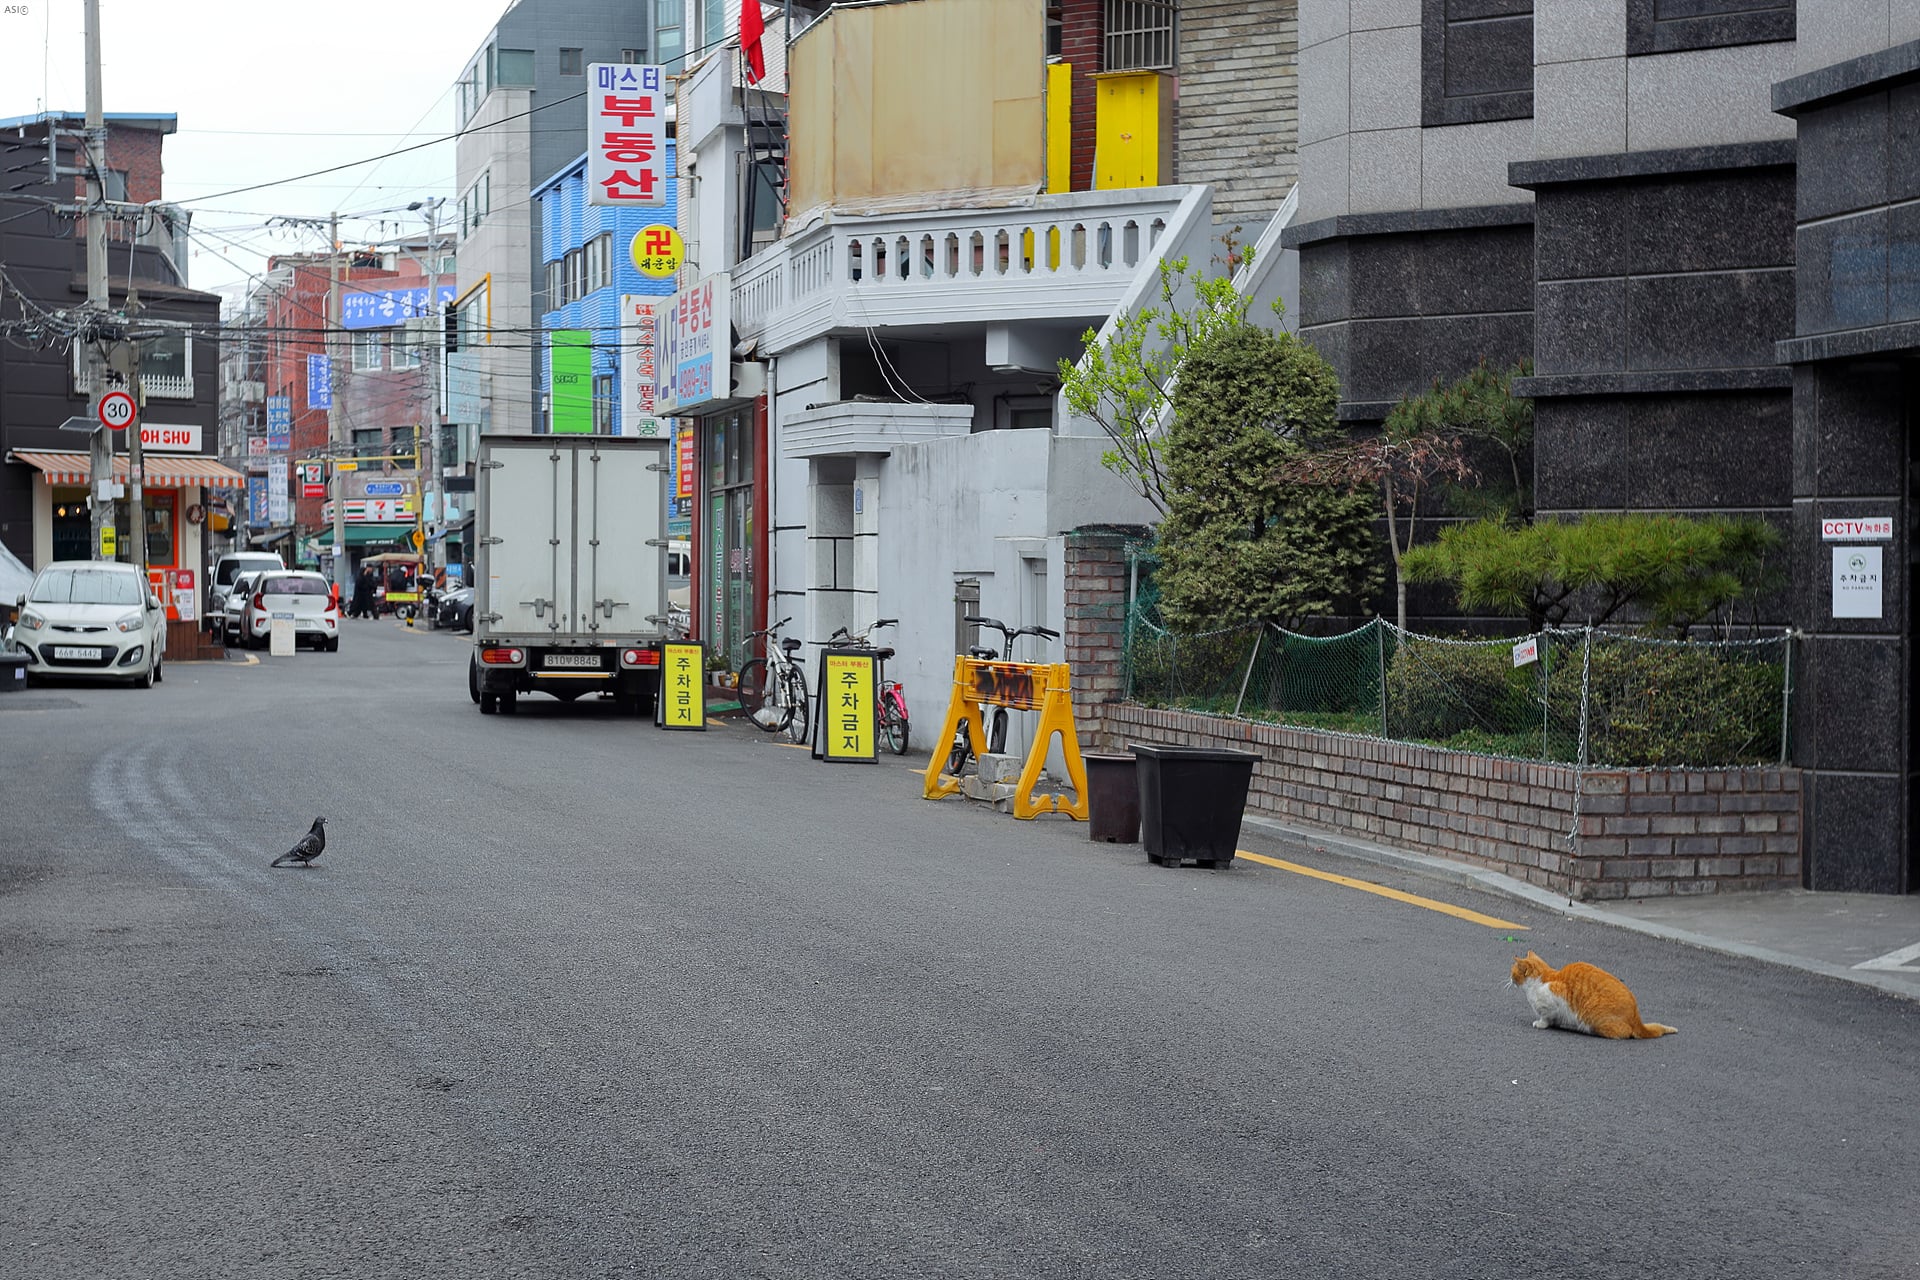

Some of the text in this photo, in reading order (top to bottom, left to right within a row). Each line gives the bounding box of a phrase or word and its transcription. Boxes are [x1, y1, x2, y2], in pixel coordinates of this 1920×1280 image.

[599, 66, 659, 91] 마스터
[600, 95, 659, 200] 부동산
[678, 280, 713, 338] 부동산
[654, 304, 677, 403] 마스터
[107, 403, 128, 418] 30
[163, 431, 191, 445] SHU
[269, 423, 289, 434] LCD
[1824, 523, 1890, 535] CCTV 녹화중
[1840, 574, 1877, 583] 주차금지
[850, 661, 869, 669] 부동산
[676, 656, 692, 722] 주차금지
[842, 672, 860, 753] 주차금지
